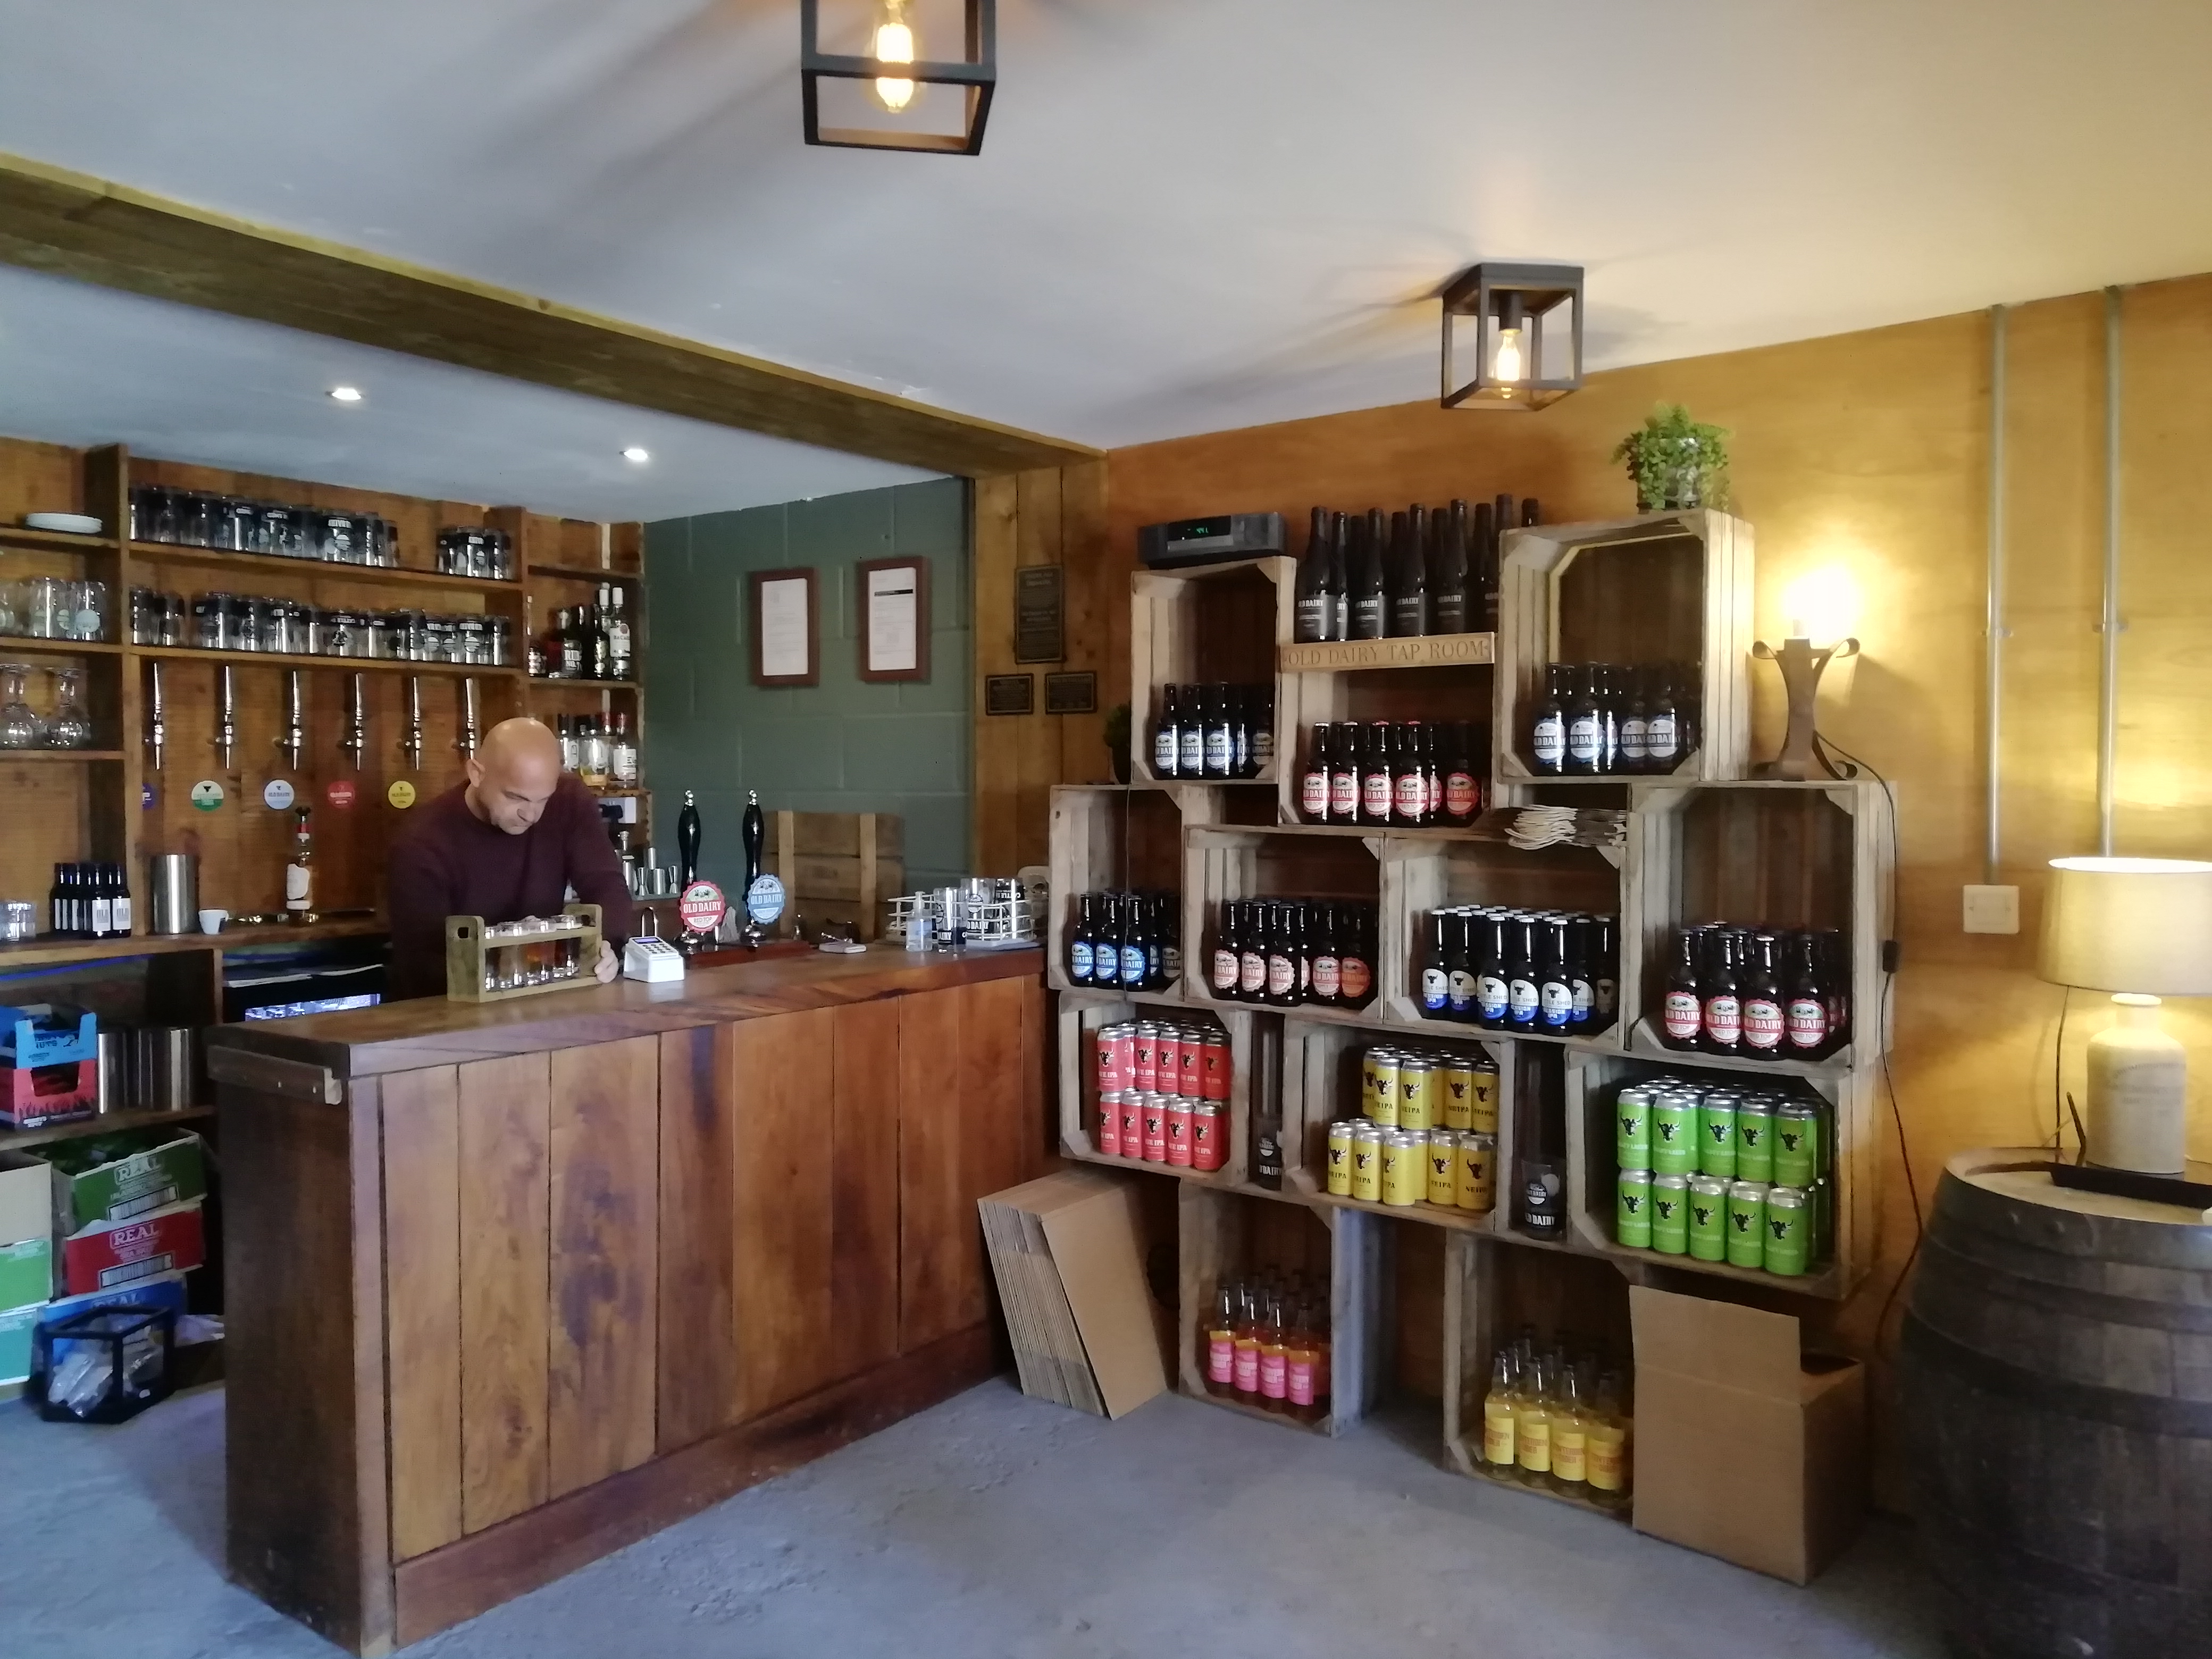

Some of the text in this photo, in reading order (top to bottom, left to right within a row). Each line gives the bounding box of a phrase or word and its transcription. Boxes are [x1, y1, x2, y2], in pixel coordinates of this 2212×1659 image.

[1288, 640, 1484, 666] OLD DAIRY TAP ROOM
[1579, 735, 1603, 744] DAIY
[751, 894, 782, 905] OLD DAIRY
[683, 901, 722, 914] OLD DAIRY
[1675, 1011, 1700, 1020] DAIRY
[1755, 1019, 1781, 1029] DAIRY
[118, 1157, 162, 1182] RL
[114, 1223, 160, 1246] REAL
